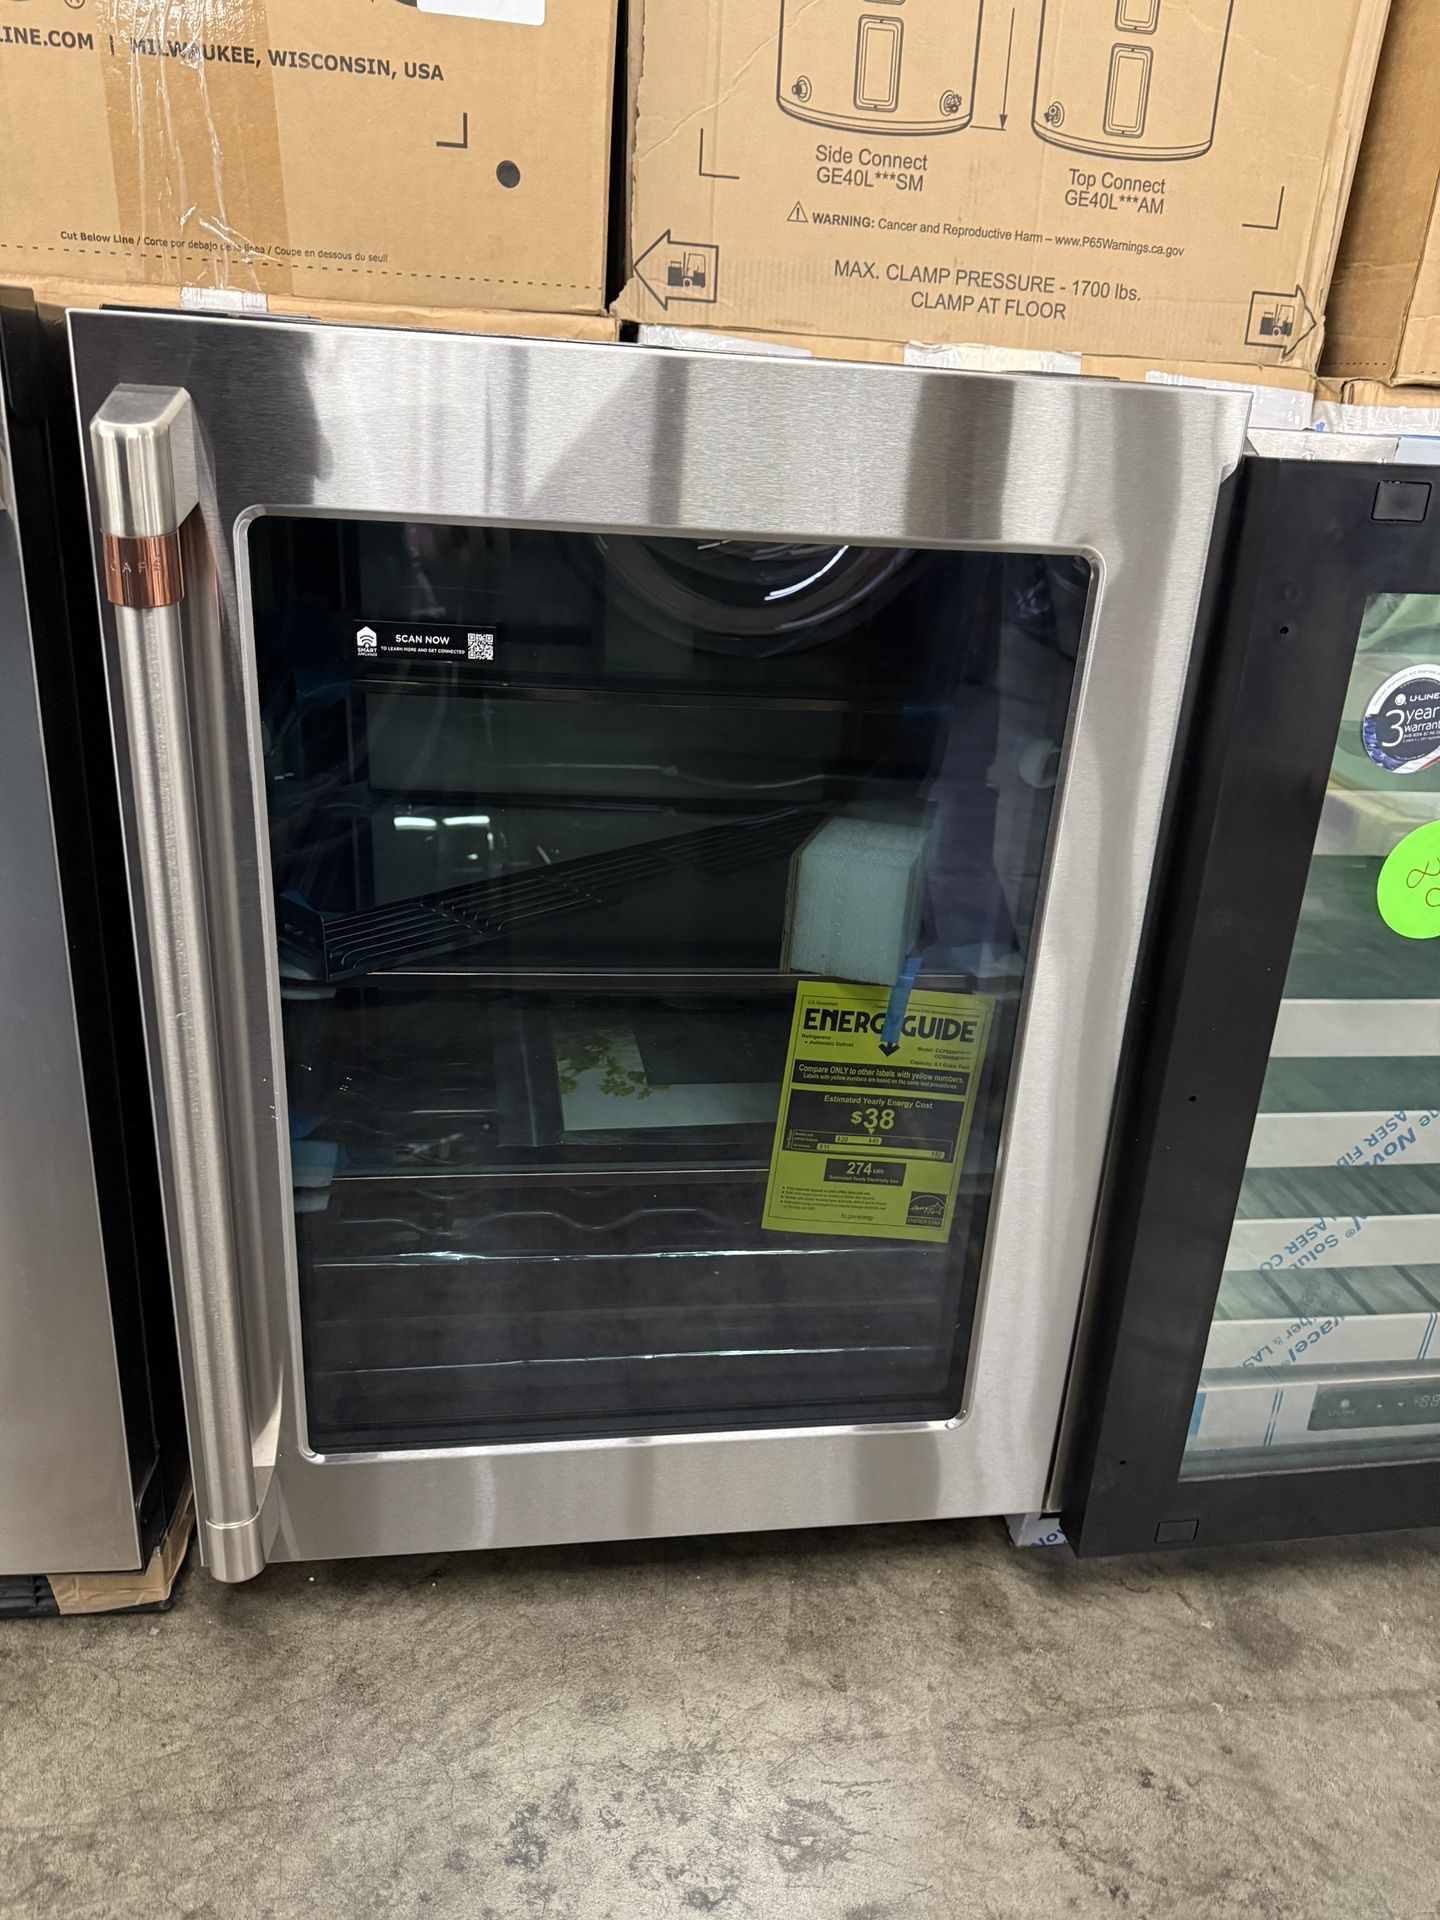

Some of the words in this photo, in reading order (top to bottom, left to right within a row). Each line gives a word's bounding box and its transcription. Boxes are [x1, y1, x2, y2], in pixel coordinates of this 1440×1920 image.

[0, 26, 94, 50] INE.COM
[268, 49, 396, 79] WISCONSIN,
[404, 62, 444, 81] USA
[816, 144, 853, 164] Side
[858, 148, 928, 171] Connect
[1069, 168, 1096, 190] Top
[1101, 172, 1166, 194] Connect
[61, 231, 78, 240] Cut
[80, 232, 111, 243] Below
[113, 235, 135, 245] Line
[144, 236, 168, 247] Corte
[171, 240, 185, 248] por
[188, 240, 218, 252] debajo
[274, 246, 302, 257] Coupe
[304, 249, 316, 258] en
[318, 250, 352, 261] dessous
[355, 251, 366, 261] du
[368, 253, 389, 263] seuil
[812, 212, 875, 229] WARNING:
[878, 218, 917, 232] Cancer
[920, 222, 941, 234] and
[943, 223, 1012, 241] Reproductive
[1015, 230, 1043, 243] Harm
[1055, 236, 1184, 257] www.P65Warnings.ca.gov
[834, 259, 879, 279] MAX.
[886, 263, 950, 284] CLAMP
[955, 269, 1056, 294] PRESSURE
[1072, 280, 1110, 299] 1700
[1114, 283, 1141, 301] lbs.
[911, 291, 974, 311] CLAMP
[977, 296, 1001, 314] AT
[1004, 299, 1066, 320] FLOOR
[395, 634, 423, 644] SCAN
[425, 635, 450, 645] NOW
[1382, 709, 1405, 747] 3
[1406, 706, 1440, 725] year
[1404, 720, 1440, 732] warrant
[803, 1007, 977, 1044] ENERGGUIDE
[799, 1063, 829, 1074] Compare
[830, 1066, 849, 1074] ONLY
[857, 1068, 875, 1076] other
[876, 1069, 895, 1077] labels
[912, 1072, 934, 1080] yellow
[934, 1075, 964, 1083] numbers.
[824, 1094, 862, 1104] Estimated
[863, 1097, 886, 1107] Yearly
[887, 1098, 914, 1109] Energy
[915, 1101, 934, 1109] Cost
[850, 1107, 896, 1130] $38
[846, 1161, 873, 1175] 274
